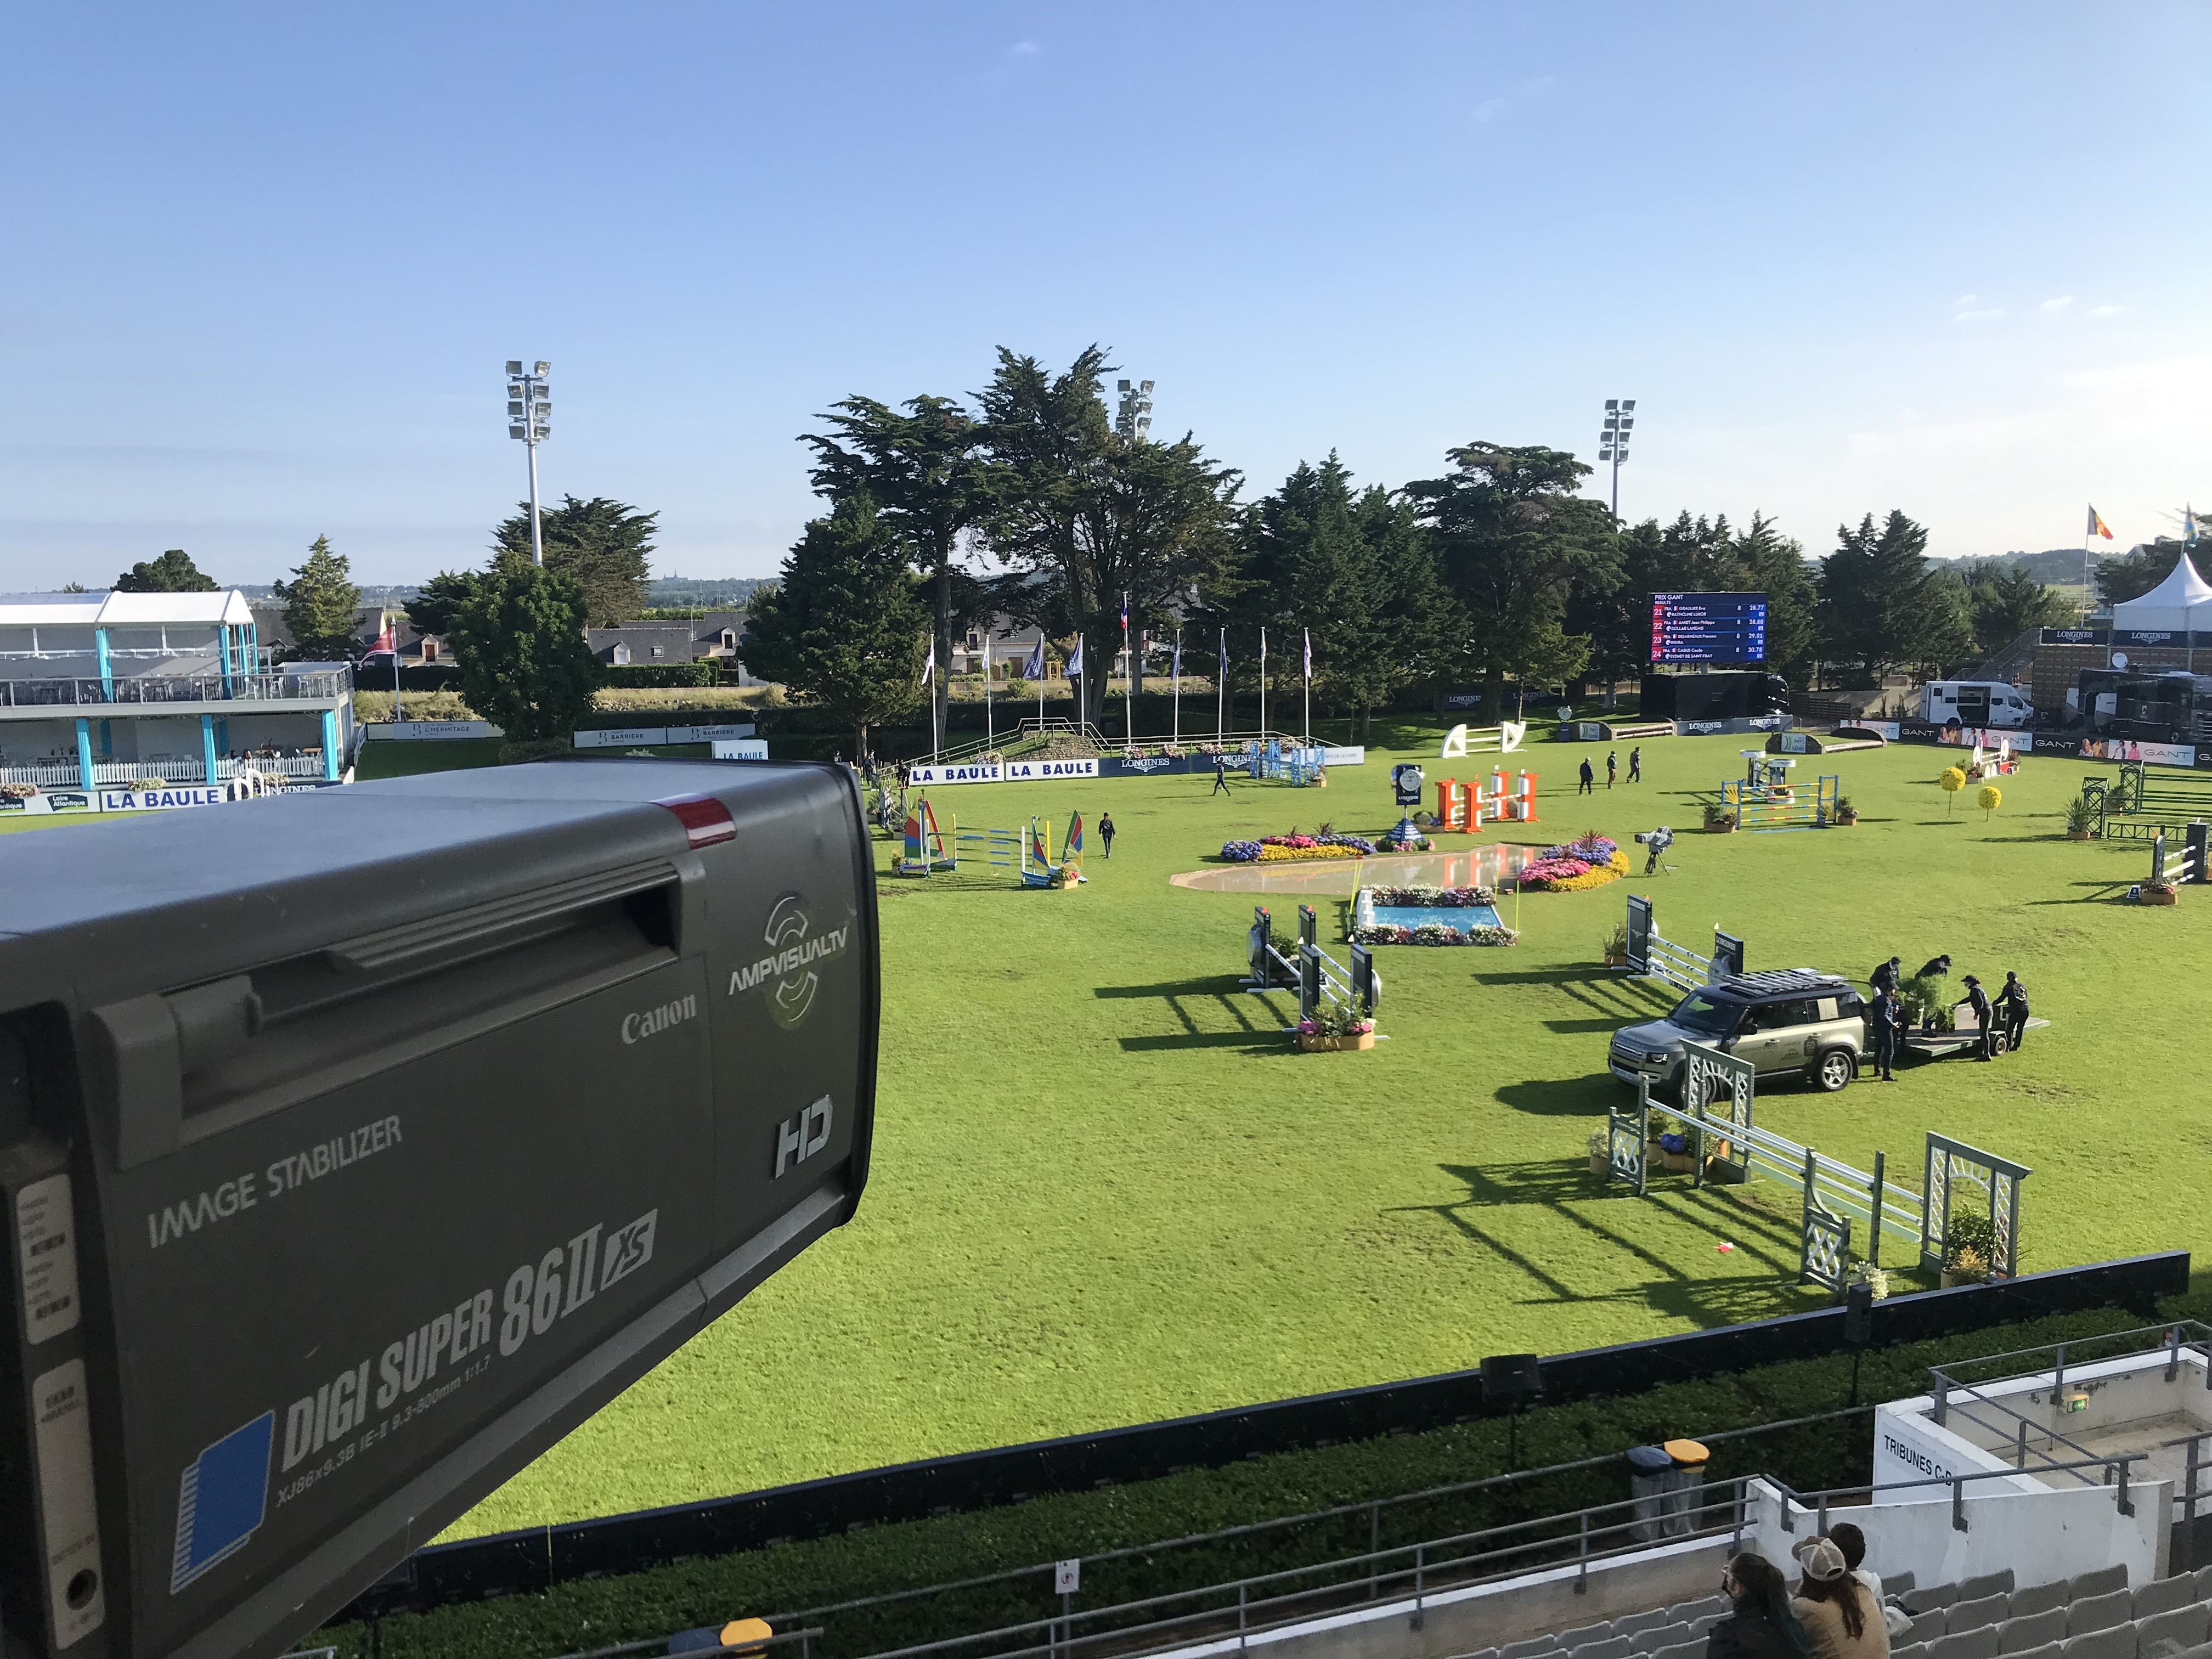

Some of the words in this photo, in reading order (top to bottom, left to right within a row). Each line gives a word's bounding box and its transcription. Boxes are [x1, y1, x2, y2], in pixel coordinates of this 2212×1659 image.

[2131, 632, 2171, 640] LONGINES
[1689, 721, 1722, 730] LONGINES
[1749, 718, 1780, 726] LONGINES
[1901, 729, 1934, 737] GANT
[1991, 736, 2028, 744] GNT
[2035, 740, 2075, 749] GANT
[1212, 754, 1251, 764] LONGIN
[2144, 749, 2192, 759] GANT
[1121, 758, 1170, 768] LONGINES
[912, 770, 934, 782] LA
[945, 766, 999, 781] BAULE
[1011, 765, 1031, 777] LA
[1042, 762, 1092, 775] BAULE
[106, 793, 136, 809] LA
[144, 789, 219, 808] BAULE
[621, 994, 696, 1045] Canon
[774, 1094, 833, 1180] HD
[147, 1172, 258, 1249] IMAGE
[266, 1114, 403, 1198] STABILIZER
[282, 1358, 371, 1473] DIGI
[377, 1288, 493, 1410] SUPER
[1884, 1435, 1932, 1476] TRIBUNES
